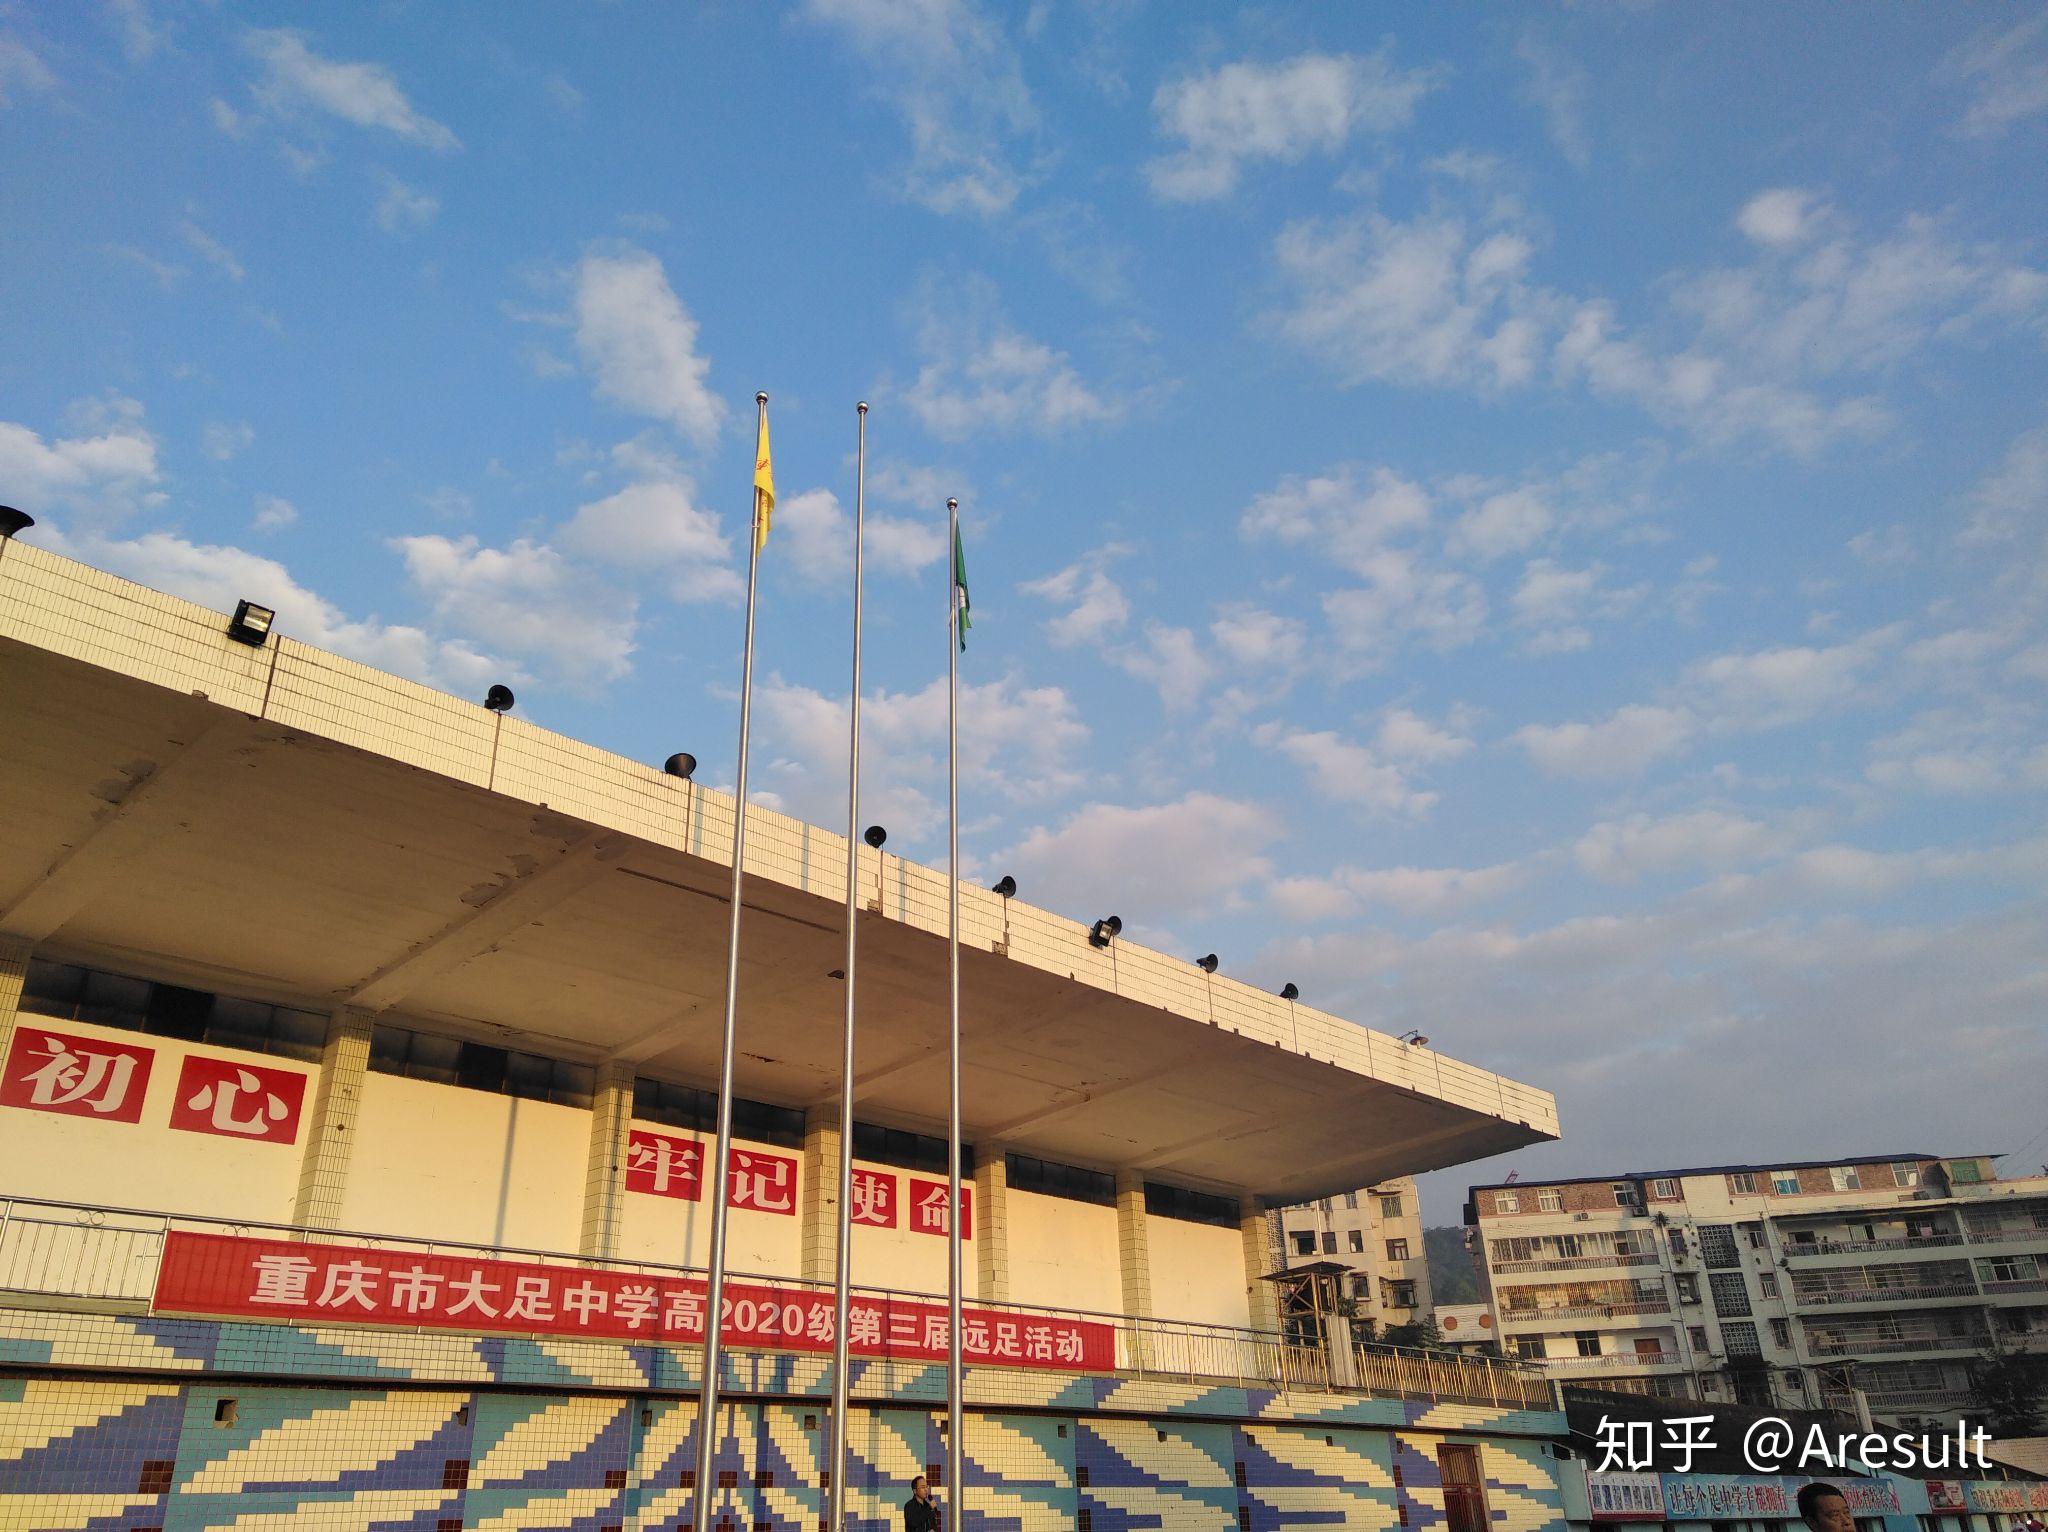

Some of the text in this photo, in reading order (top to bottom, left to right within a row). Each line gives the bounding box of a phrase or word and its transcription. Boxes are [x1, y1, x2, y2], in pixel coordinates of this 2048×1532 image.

[20, 1037, 288, 1135] 初心
[627, 1138, 964, 1233] 牢记使命
[249, 1255, 1084, 1362] 重庆市大足中学高2020级第三届远足活动
